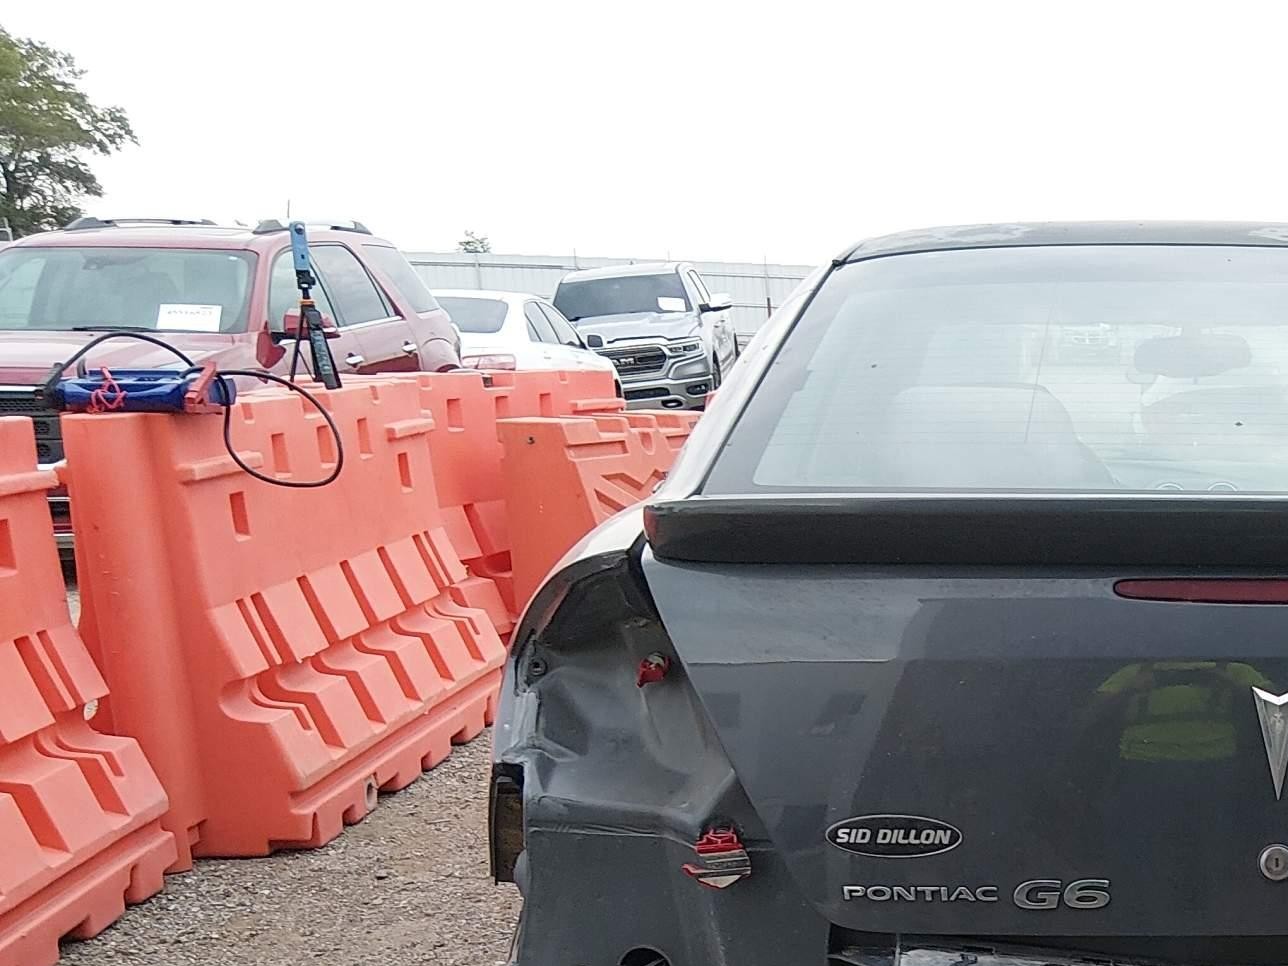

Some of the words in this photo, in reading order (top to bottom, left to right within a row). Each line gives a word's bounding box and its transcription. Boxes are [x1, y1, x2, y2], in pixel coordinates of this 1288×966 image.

[836, 828, 871, 845] SID
[876, 829, 952, 846] DILLON
[842, 884, 999, 902] PONTIAC
[1013, 879, 1112, 910] G6
